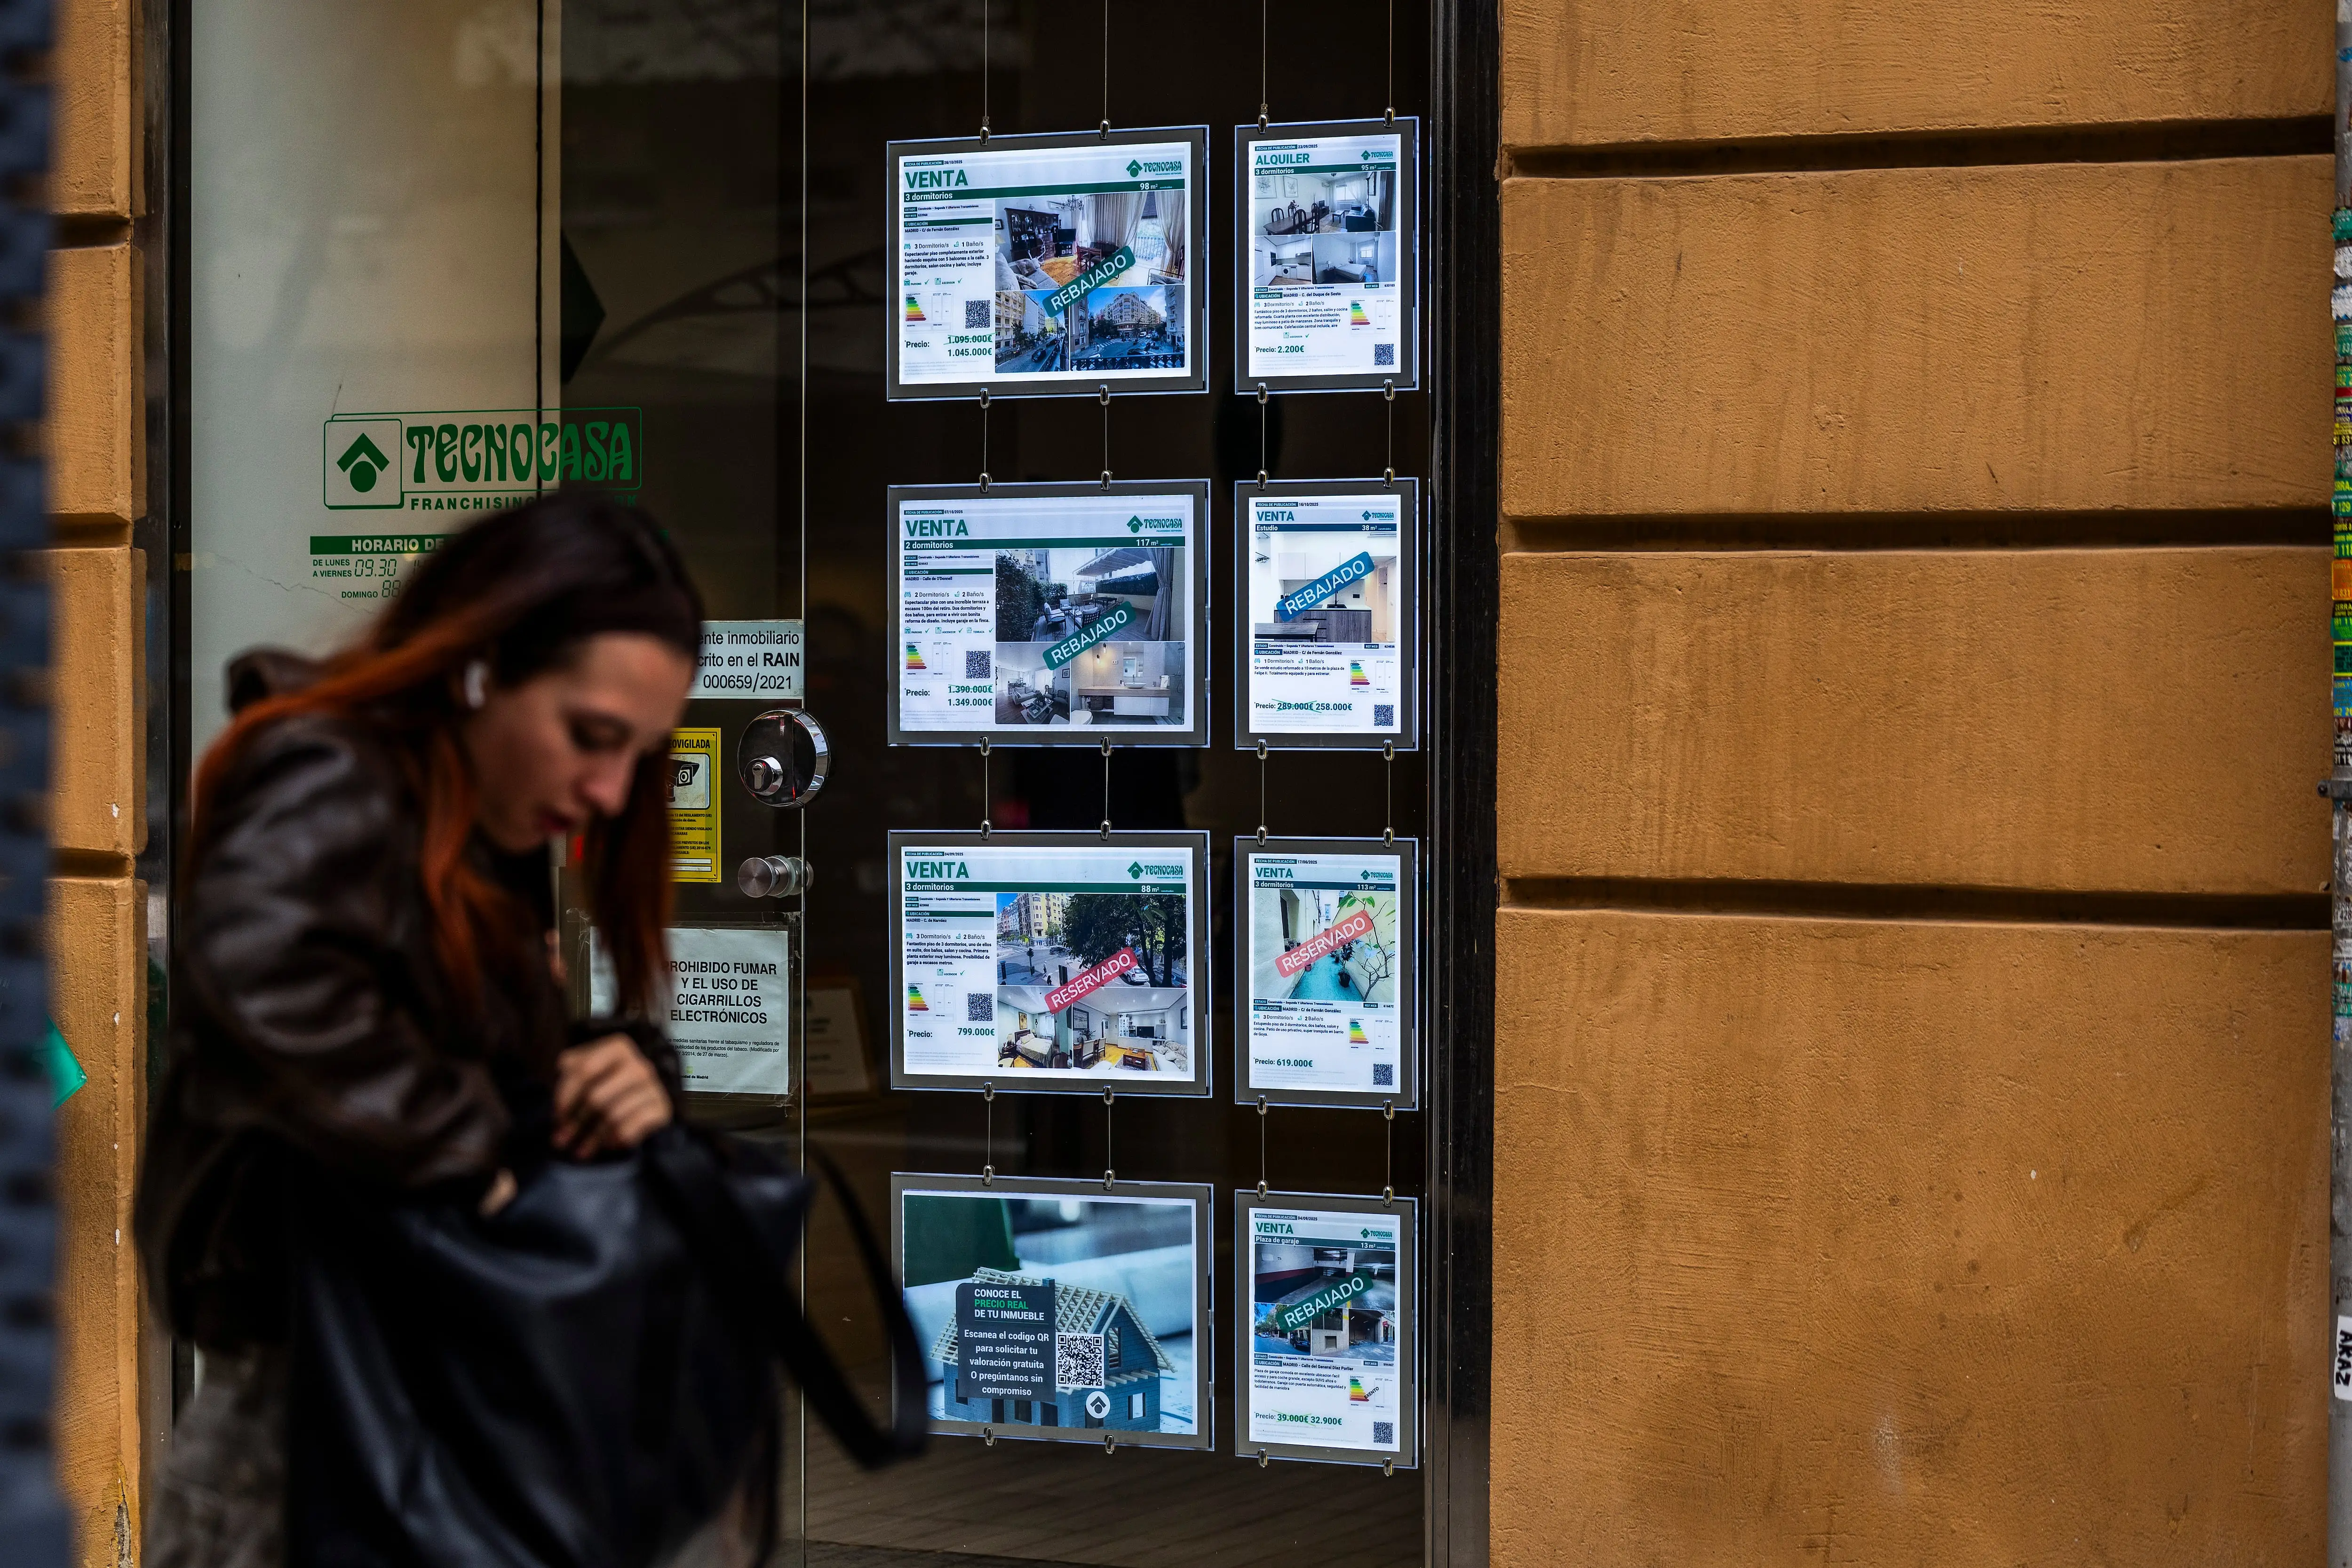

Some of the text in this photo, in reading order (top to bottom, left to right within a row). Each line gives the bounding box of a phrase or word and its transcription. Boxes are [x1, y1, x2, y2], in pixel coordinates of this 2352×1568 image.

[1255, 153, 1310, 165] ALQUILER
[1143, 161, 1182, 173] TECNOCASA
[905, 169, 968, 188] VENTA
[912, 192, 953, 200] dormitorios
[1050, 255, 1126, 310] REBAJADO
[947, 335, 992, 344] 1.095.000€
[947, 348, 992, 357] 1.045.000€
[406, 422, 632, 483] TECNOCASA
[1256, 511, 1295, 521] VENTA
[905, 519, 969, 536] VENTA
[1144, 518, 1182, 528] TECNOCASA
[352, 539, 444, 551] HORARIO DE
[354, 559, 397, 577] 09.30
[1285, 560, 1365, 615] REBAJADO
[699, 630, 799, 645] ente inmobiliario
[1051, 610, 1127, 664] REBAJADO
[698, 653, 799, 667] crito en el RAIN
[703, 673, 791, 692] 000659/2021
[1316, 702, 1352, 711] 258.000€
[669, 739, 710, 749] EOVIGILADA
[906, 862, 969, 878] VENTA
[1144, 865, 1183, 876] TECNOCASA
[1255, 868, 1293, 878] VENTA
[1282, 917, 1365, 971] RESERVADO
[670, 961, 777, 975] ROHIBIDO FUMAR
[681, 978, 758, 990] Y EL USO DE
[1051, 954, 1130, 1008] RESERVADO
[677, 994, 761, 1007] CIGARRILLOS
[670, 1009, 767, 1024] ELECTRÓNICOS
[1277, 1059, 1313, 1067] 619.000€
[1255, 1222, 1293, 1234] VENTA
[974, 1289, 1021, 1299] CONOCE EL
[974, 1299, 1028, 1309] PRECIO REAL
[1284, 1277, 1364, 1327] REBAJADO
[987, 1310, 999, 1318] TU
[1001, 1311, 1044, 1321] INMUEBLE
[964, 1329, 1049, 1342] Escanea el codigo QR
[976, 1345, 1038, 1355] para solicitar tu
[969, 1358, 1044, 1369] valoración gratuita
[979, 1371, 1029, 1383] pregúntanos
[1031, 1374, 1043, 1383] sin
[982, 1387, 1032, 1397] compromiso
[1364, 1386, 1379, 1399] EXENTO
[1277, 1413, 1308, 1423] 39.000€
[1311, 1416, 1342, 1425] 32.900€
